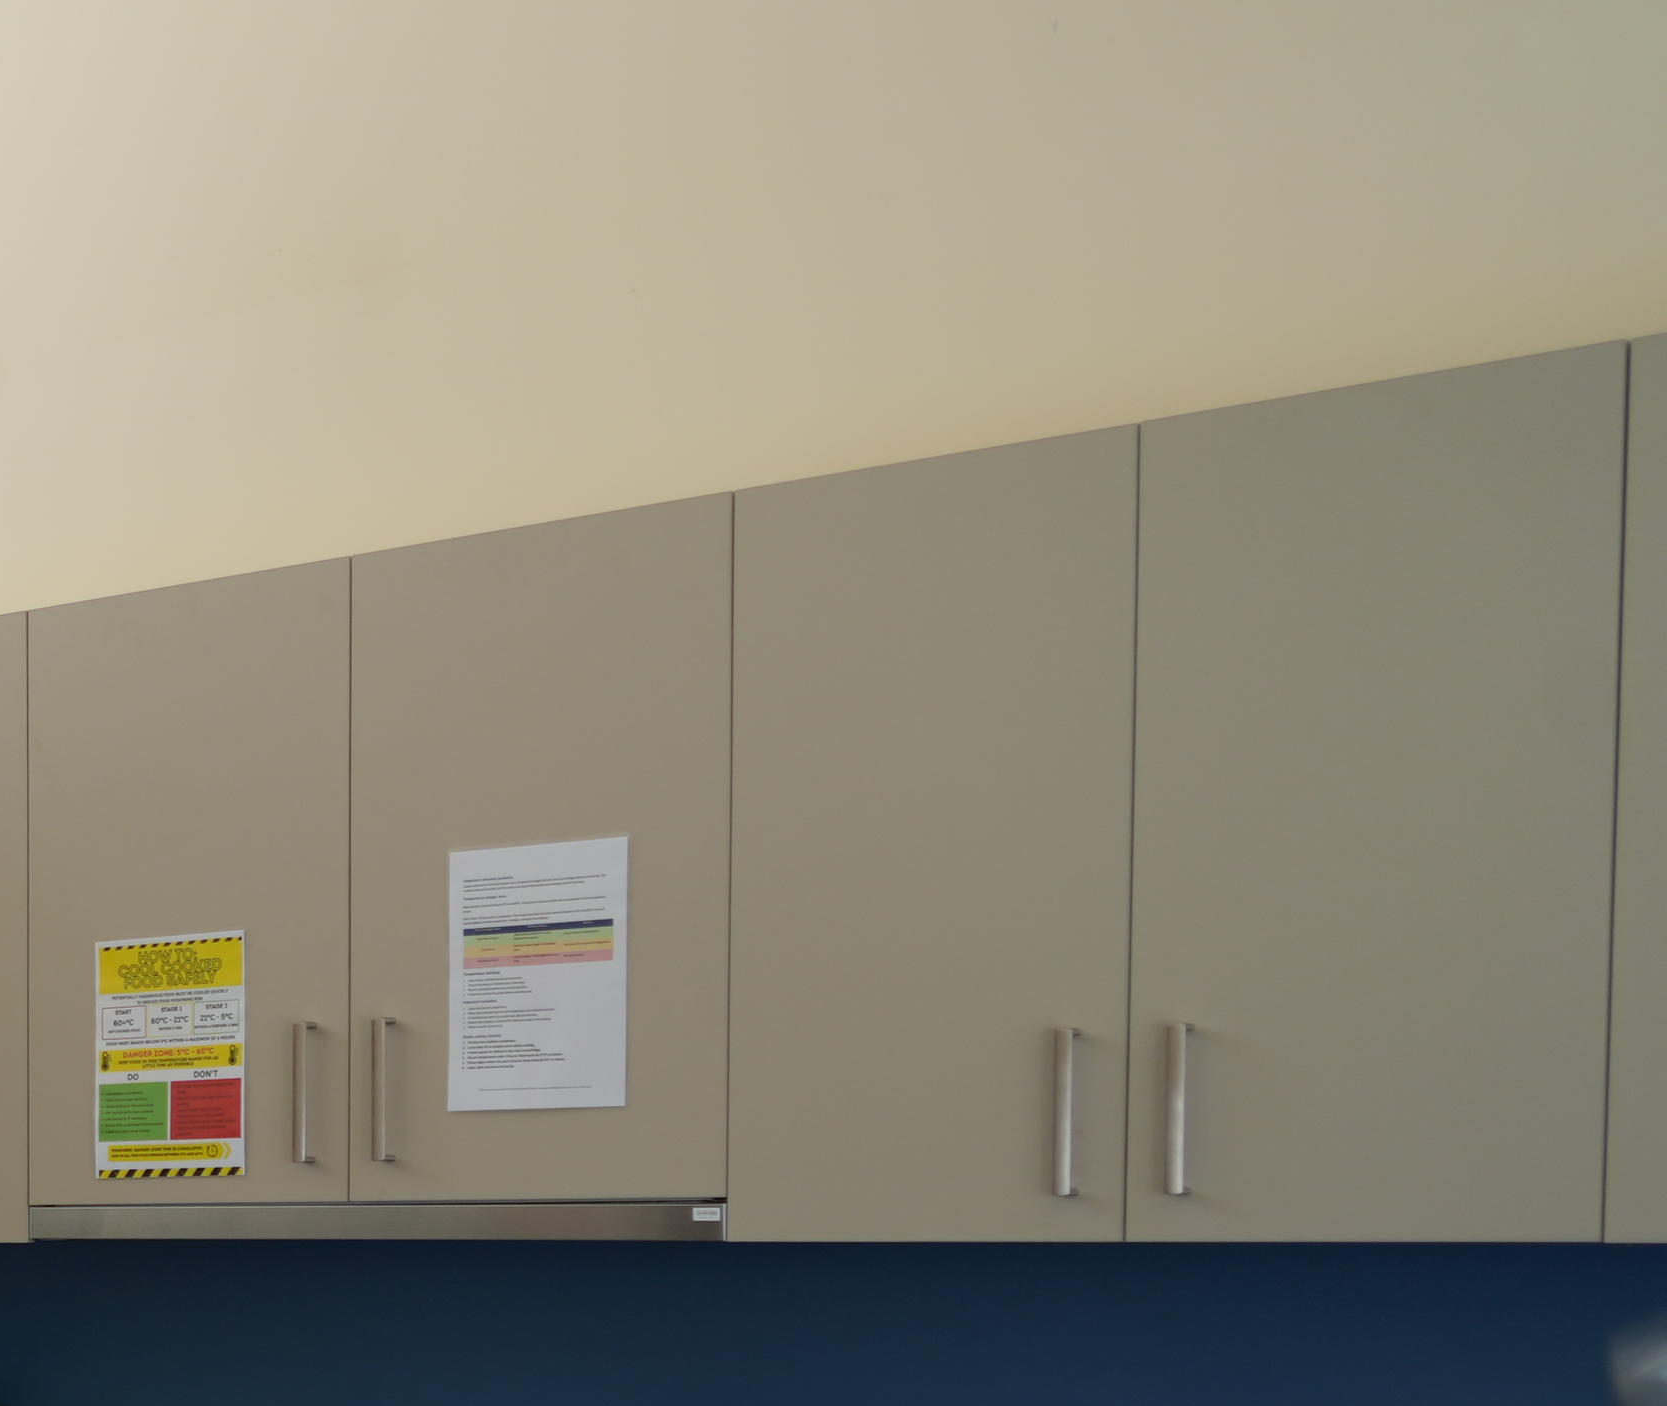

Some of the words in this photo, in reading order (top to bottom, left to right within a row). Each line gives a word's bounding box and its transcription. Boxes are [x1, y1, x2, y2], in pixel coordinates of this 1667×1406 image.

[138, 950, 172, 964] HOW
[118, 964, 159, 978] COOL
[161, 958, 223, 976] COOKED
[124, 975, 163, 990] FOOD
[167, 971, 217, 986] SAFELY
[123, 1051, 153, 1059] DANGER
[127, 1073, 139, 1081] DO
[194, 1070, 218, 1078] DON'T
